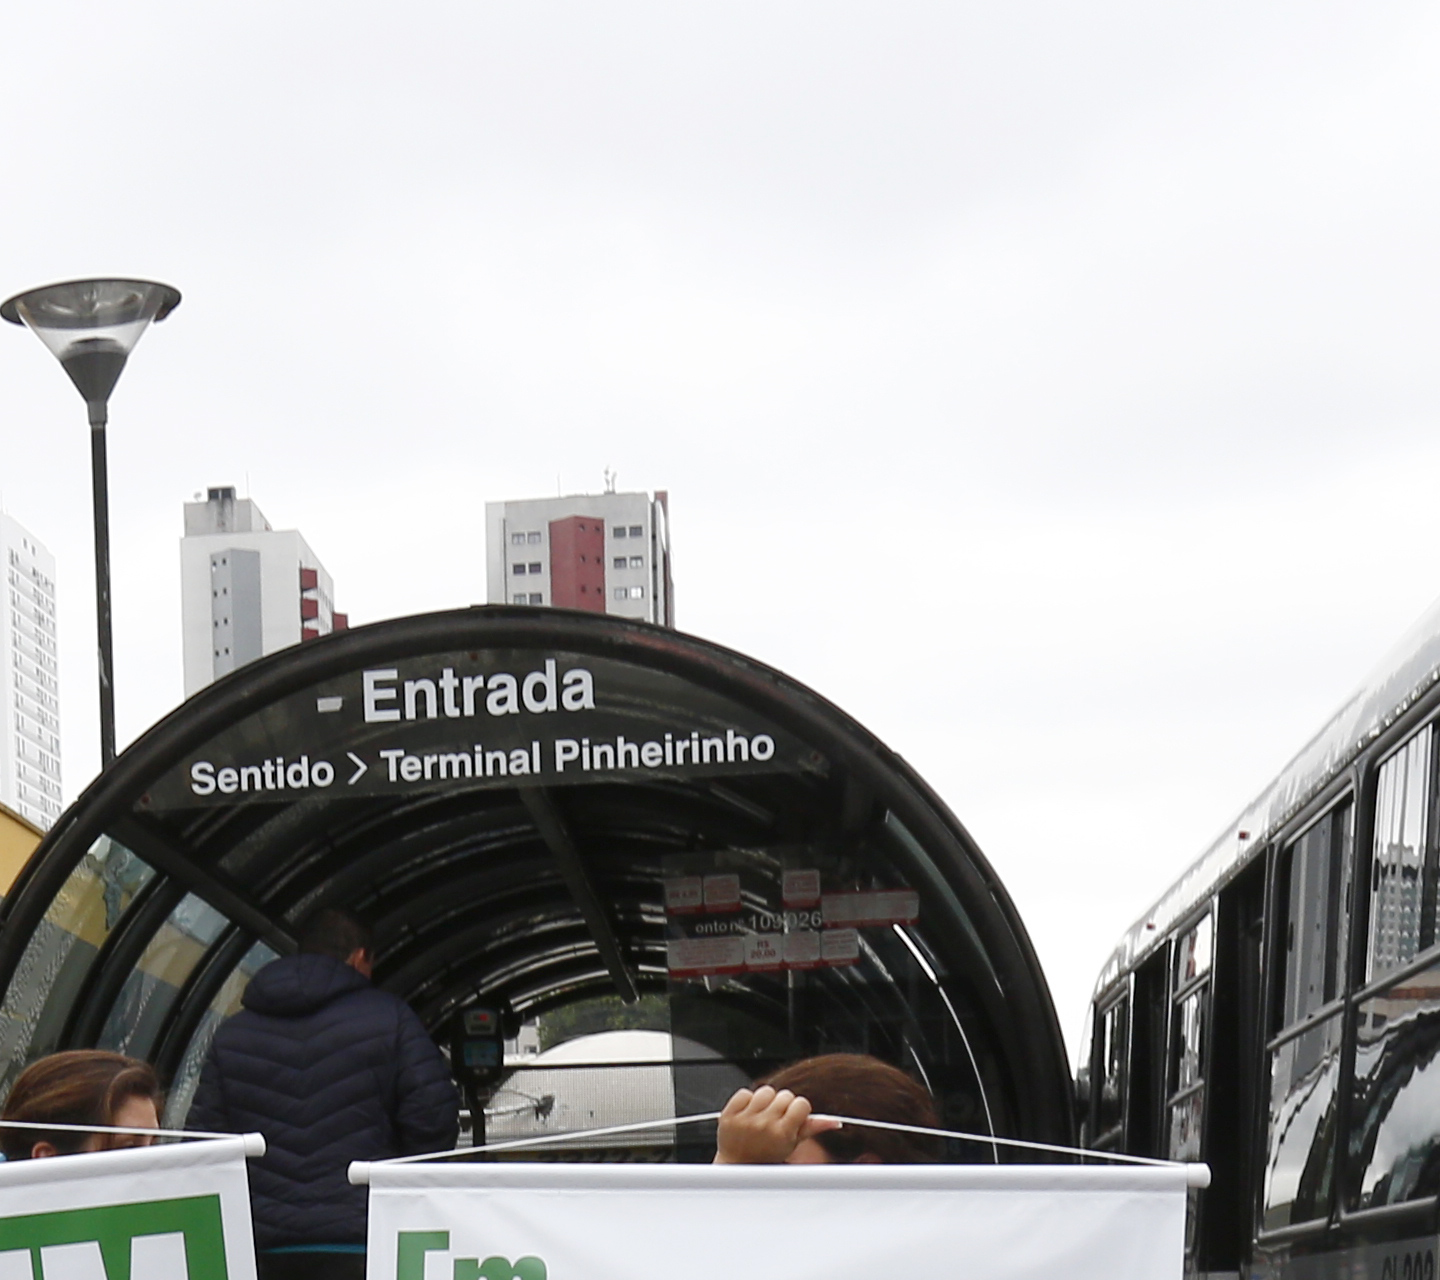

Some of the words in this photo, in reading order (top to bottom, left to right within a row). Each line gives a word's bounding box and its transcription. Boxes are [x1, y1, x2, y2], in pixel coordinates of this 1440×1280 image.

[363, 658, 596, 723] Entrada
[191, 754, 335, 796] Sentido
[379, 740, 541, 783] Terminal
[555, 729, 776, 773] Pinheirinho
